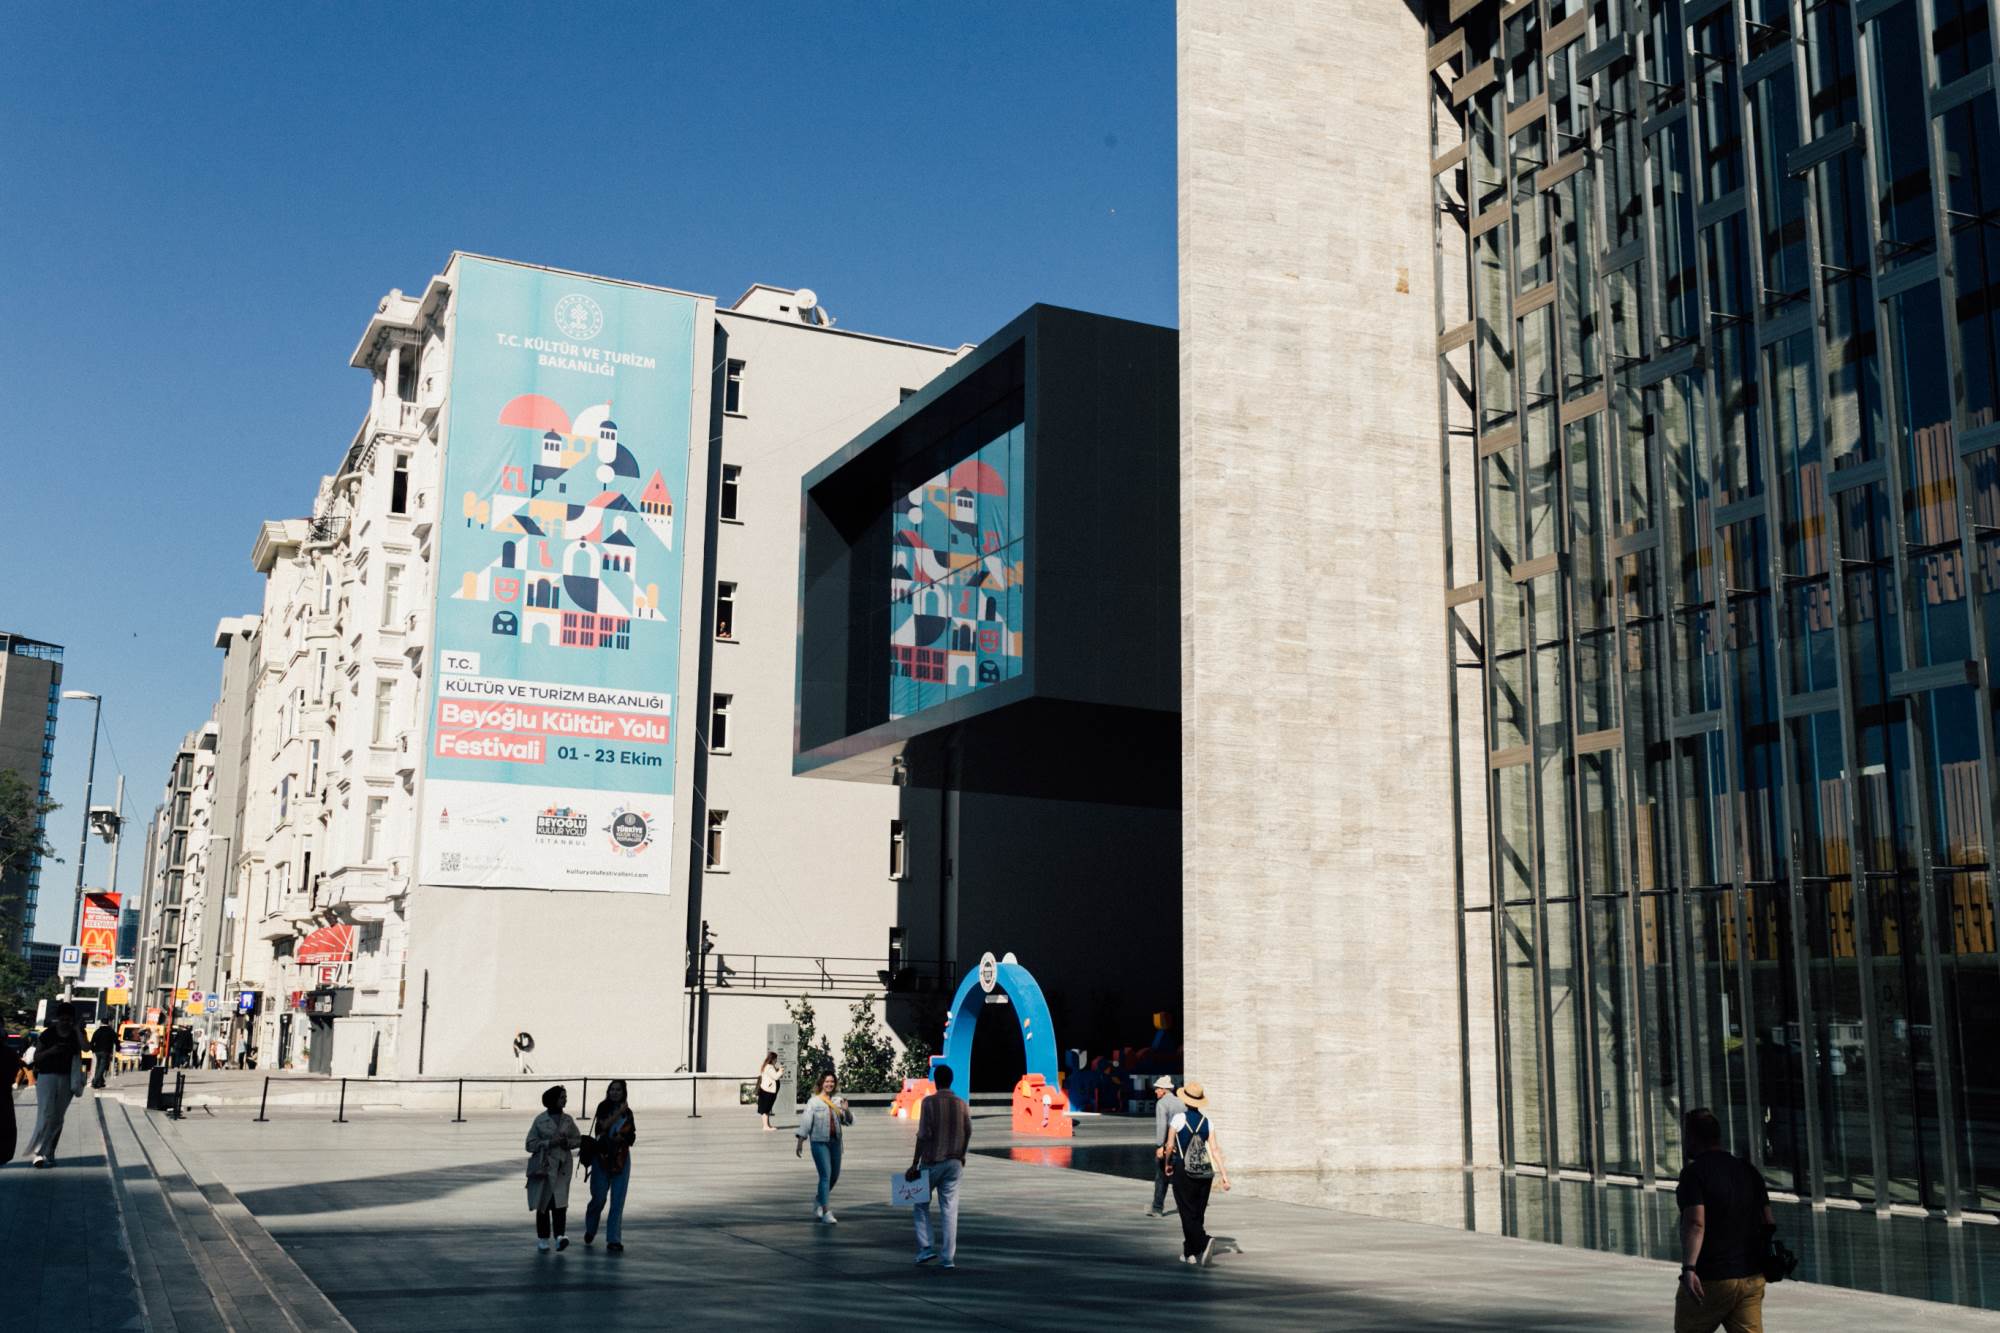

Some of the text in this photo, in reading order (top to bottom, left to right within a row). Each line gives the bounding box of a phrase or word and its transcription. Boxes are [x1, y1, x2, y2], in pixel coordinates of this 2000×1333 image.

[496, 332, 656, 369] T.C. KÜLTÜR VE TURİZM
[538, 354, 615, 377] BAKANLIĞI
[447, 657, 473, 670] T.C.
[446, 679, 664, 709] KÜLTÜR VE TURİZM BAKANLIĞI
[442, 703, 666, 740] Beyoğlu Kültür Yolu
[440, 734, 541, 760] Festivali
[557, 747, 578, 760] 01
[595, 749, 615, 763] 23
[620, 751, 662, 767] Ekim
